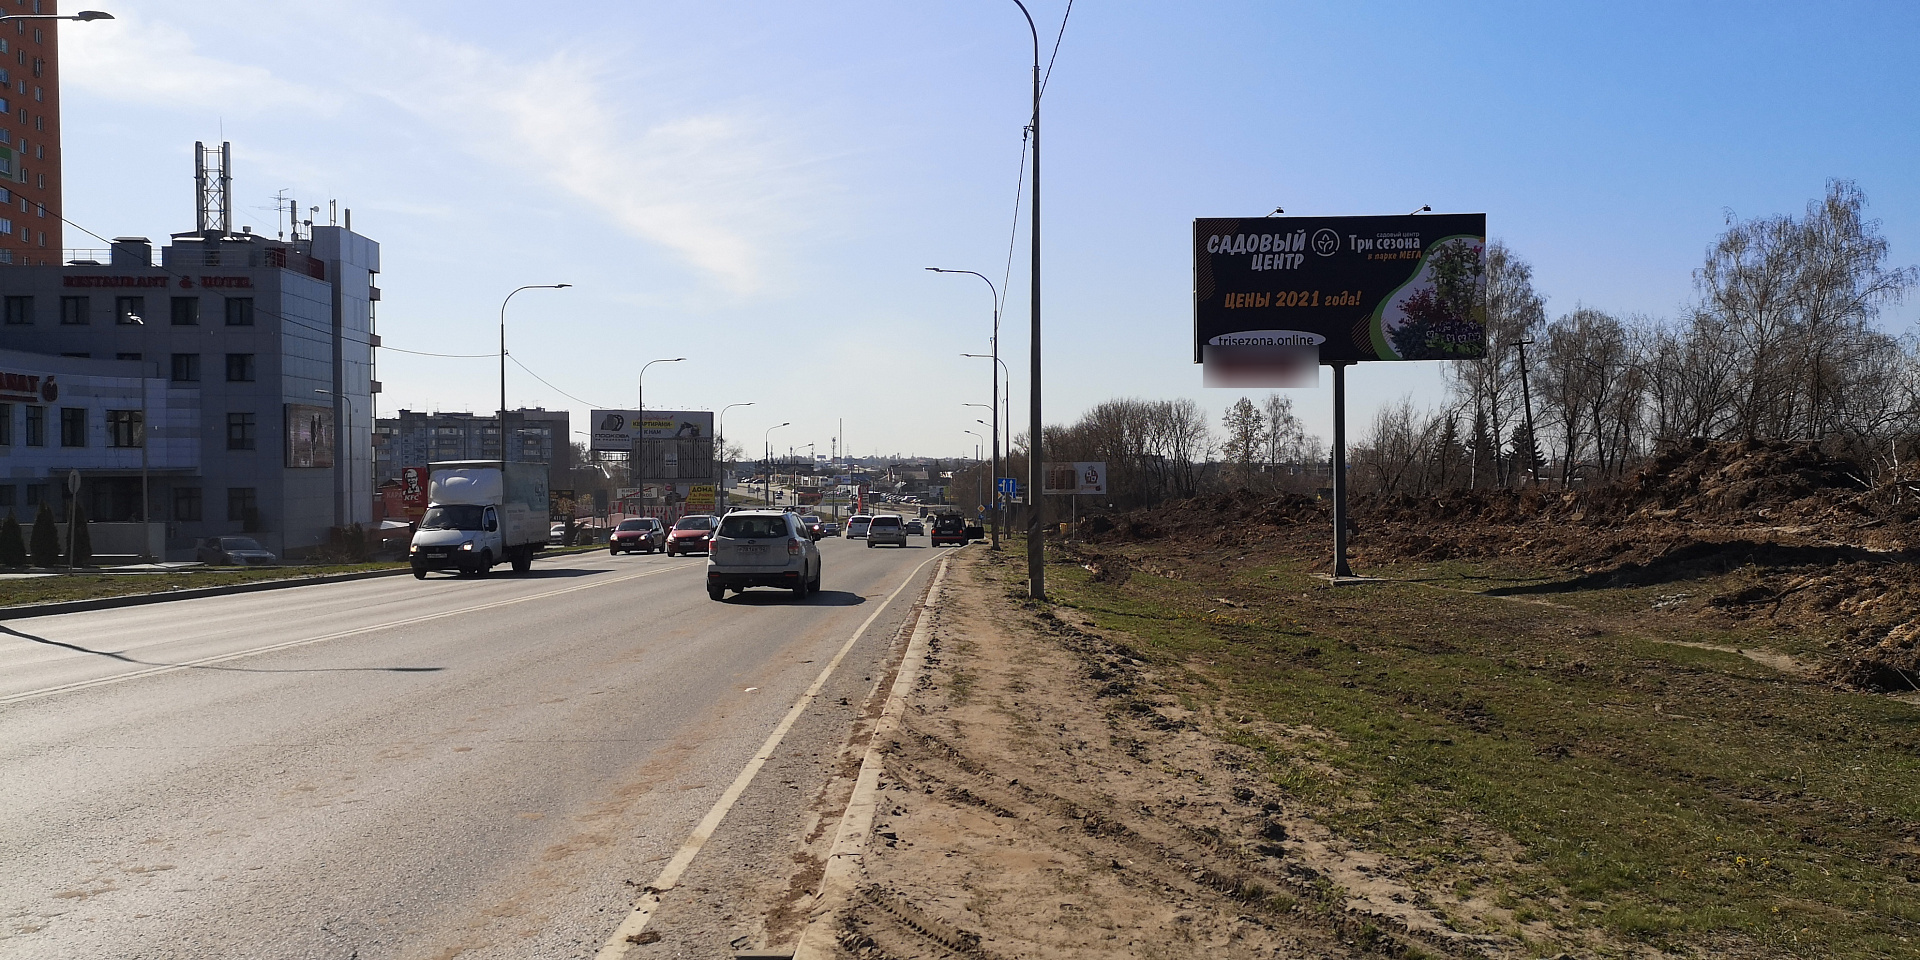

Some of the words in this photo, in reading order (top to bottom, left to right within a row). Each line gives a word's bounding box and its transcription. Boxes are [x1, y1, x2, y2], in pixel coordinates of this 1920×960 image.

[1207, 229, 1307, 255] САДОВЫЙ
[1348, 234, 1373, 253] Три
[1376, 238, 1421, 249] сезона
[1251, 253, 1305, 271] ЦЕНТР
[1374, 253, 1397, 261] парке
[1399, 250, 1422, 259] МЕГА
[63, 275, 169, 287] RESTAURANT
[1224, 292, 1270, 309] ЦЕНЫ
[1275, 290, 1320, 307] 2021
[1324, 290, 1362, 306] года!
[1218, 335, 1314, 346] trisezona.online
